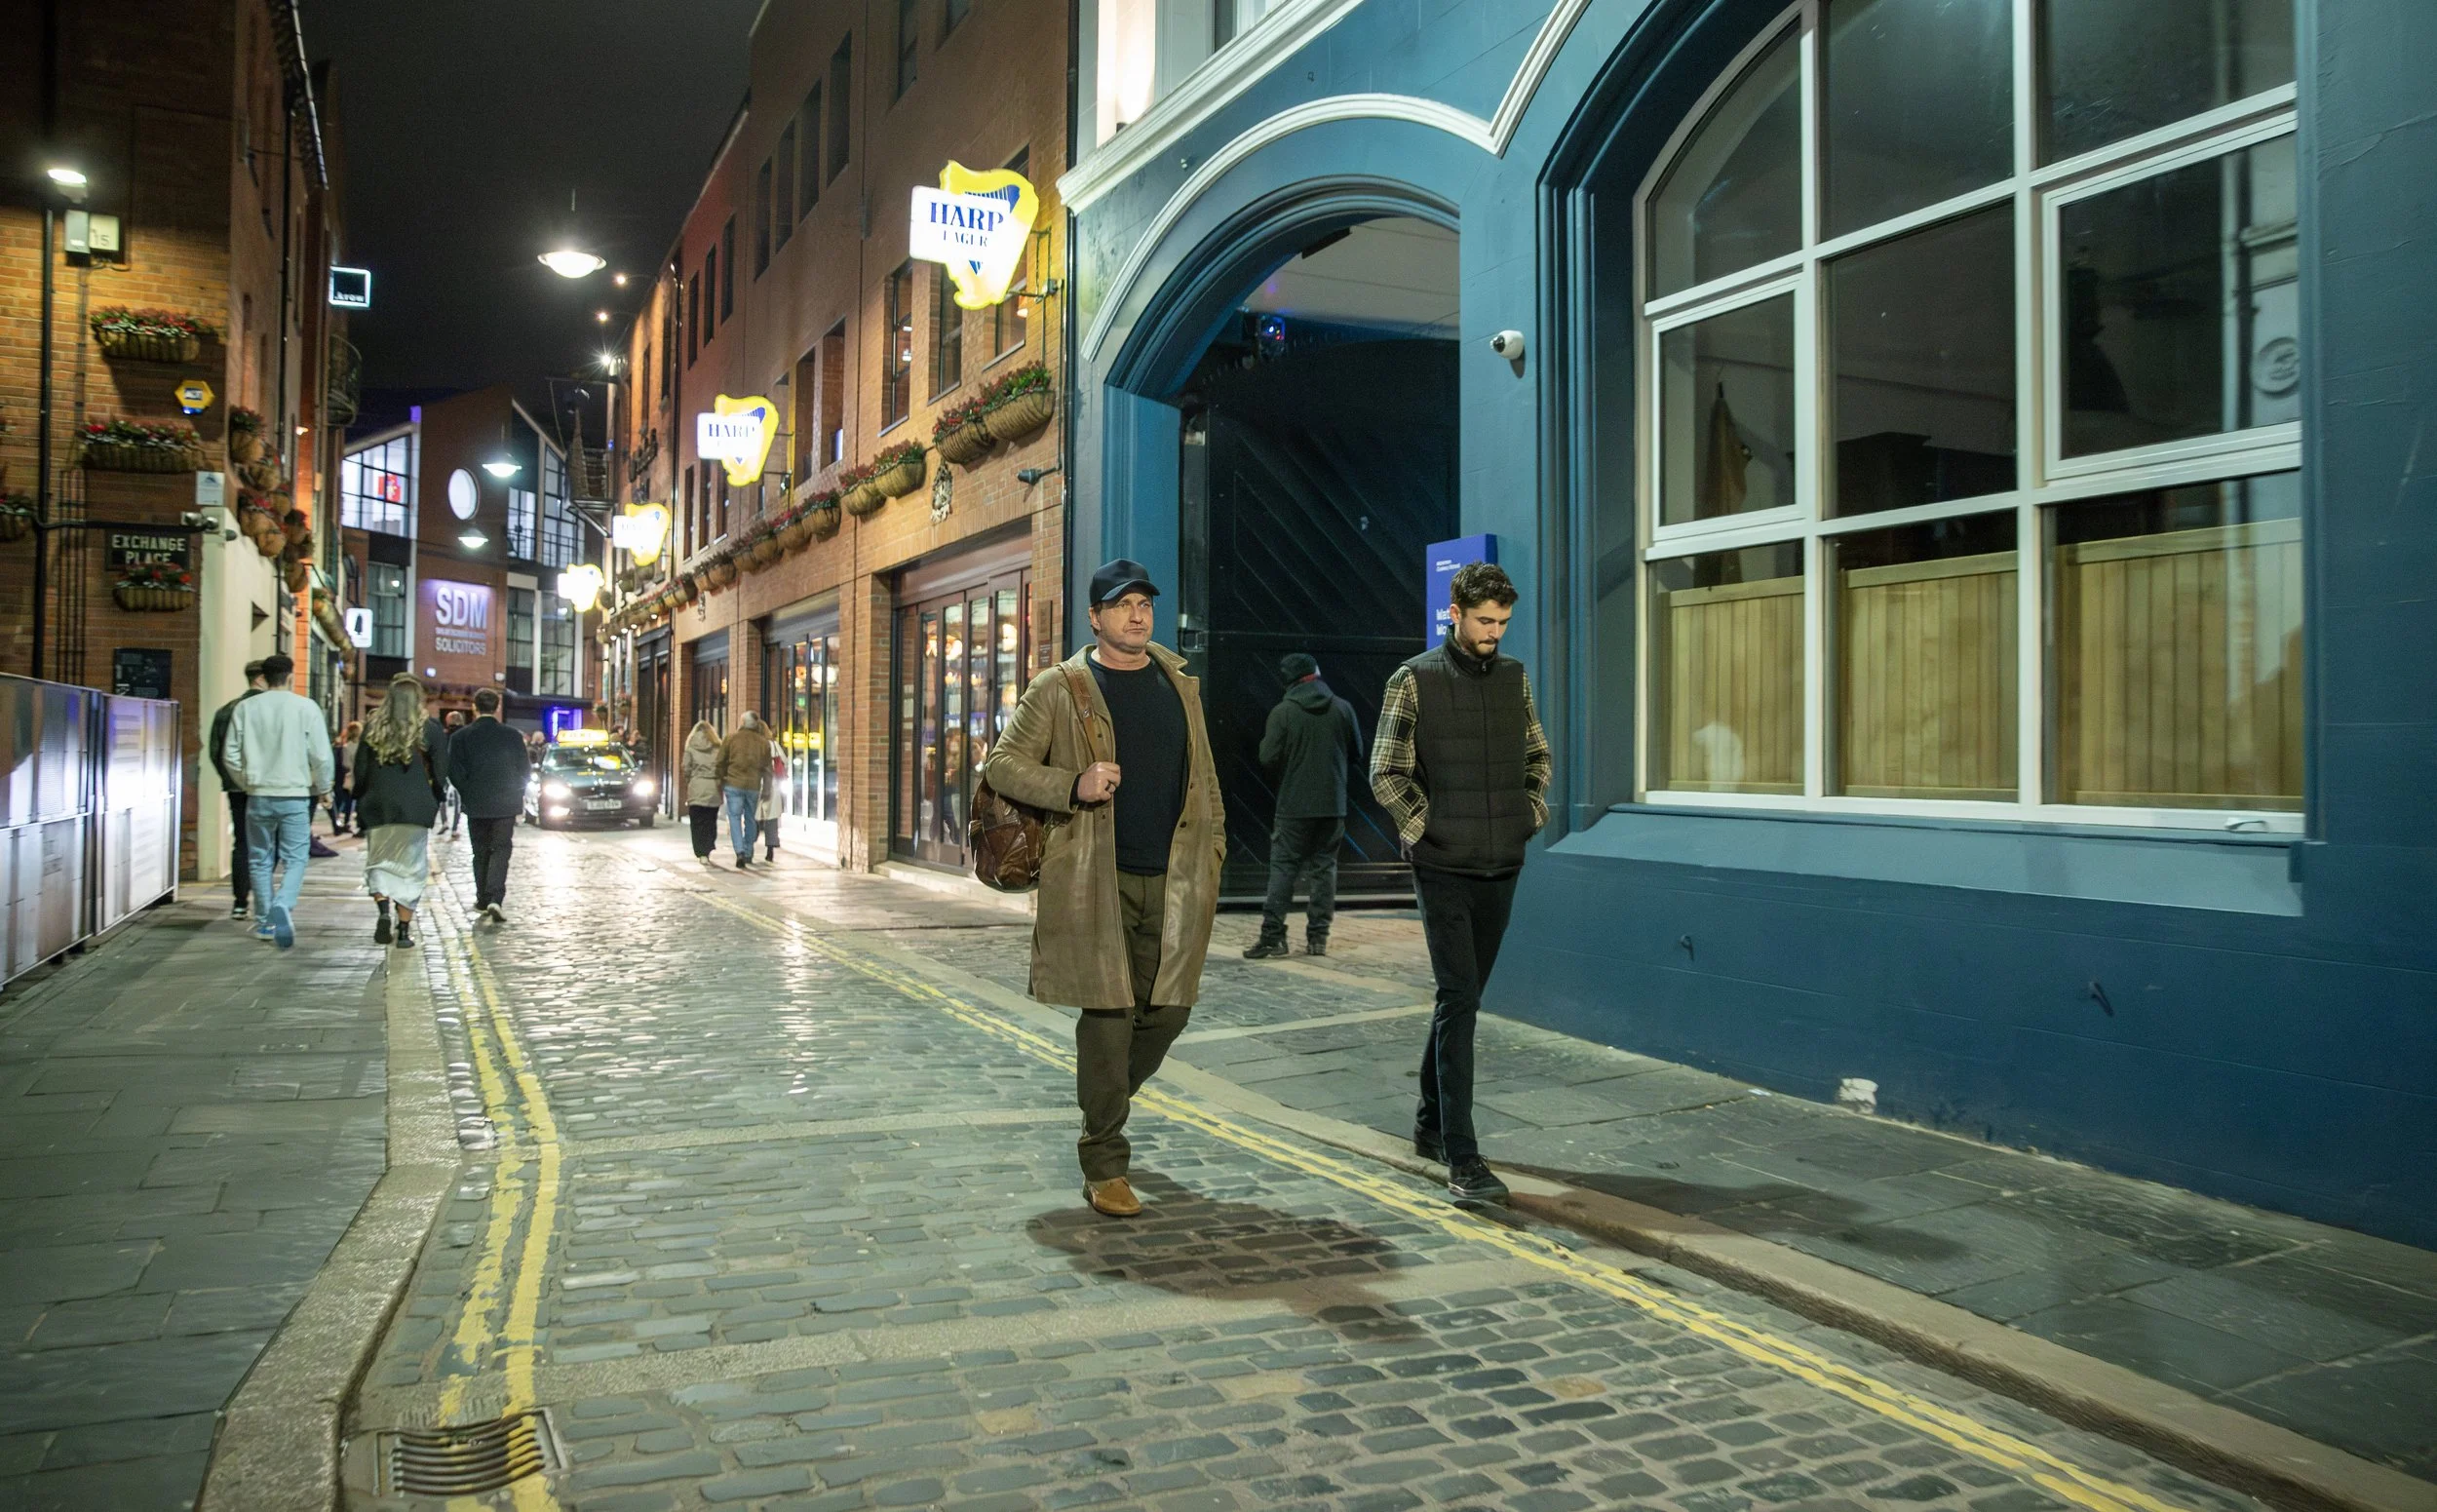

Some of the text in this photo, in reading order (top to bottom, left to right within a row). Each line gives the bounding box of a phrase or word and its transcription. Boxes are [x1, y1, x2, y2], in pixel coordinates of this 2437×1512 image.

[930, 201, 1004, 232] HARP
[708, 423, 755, 438] HARP
[112, 534, 186, 552] EXCHANGE
[125, 550, 172, 564] PLACE
[436, 587, 488, 629] SDM
[436, 637, 486, 656] SOLICITORS
